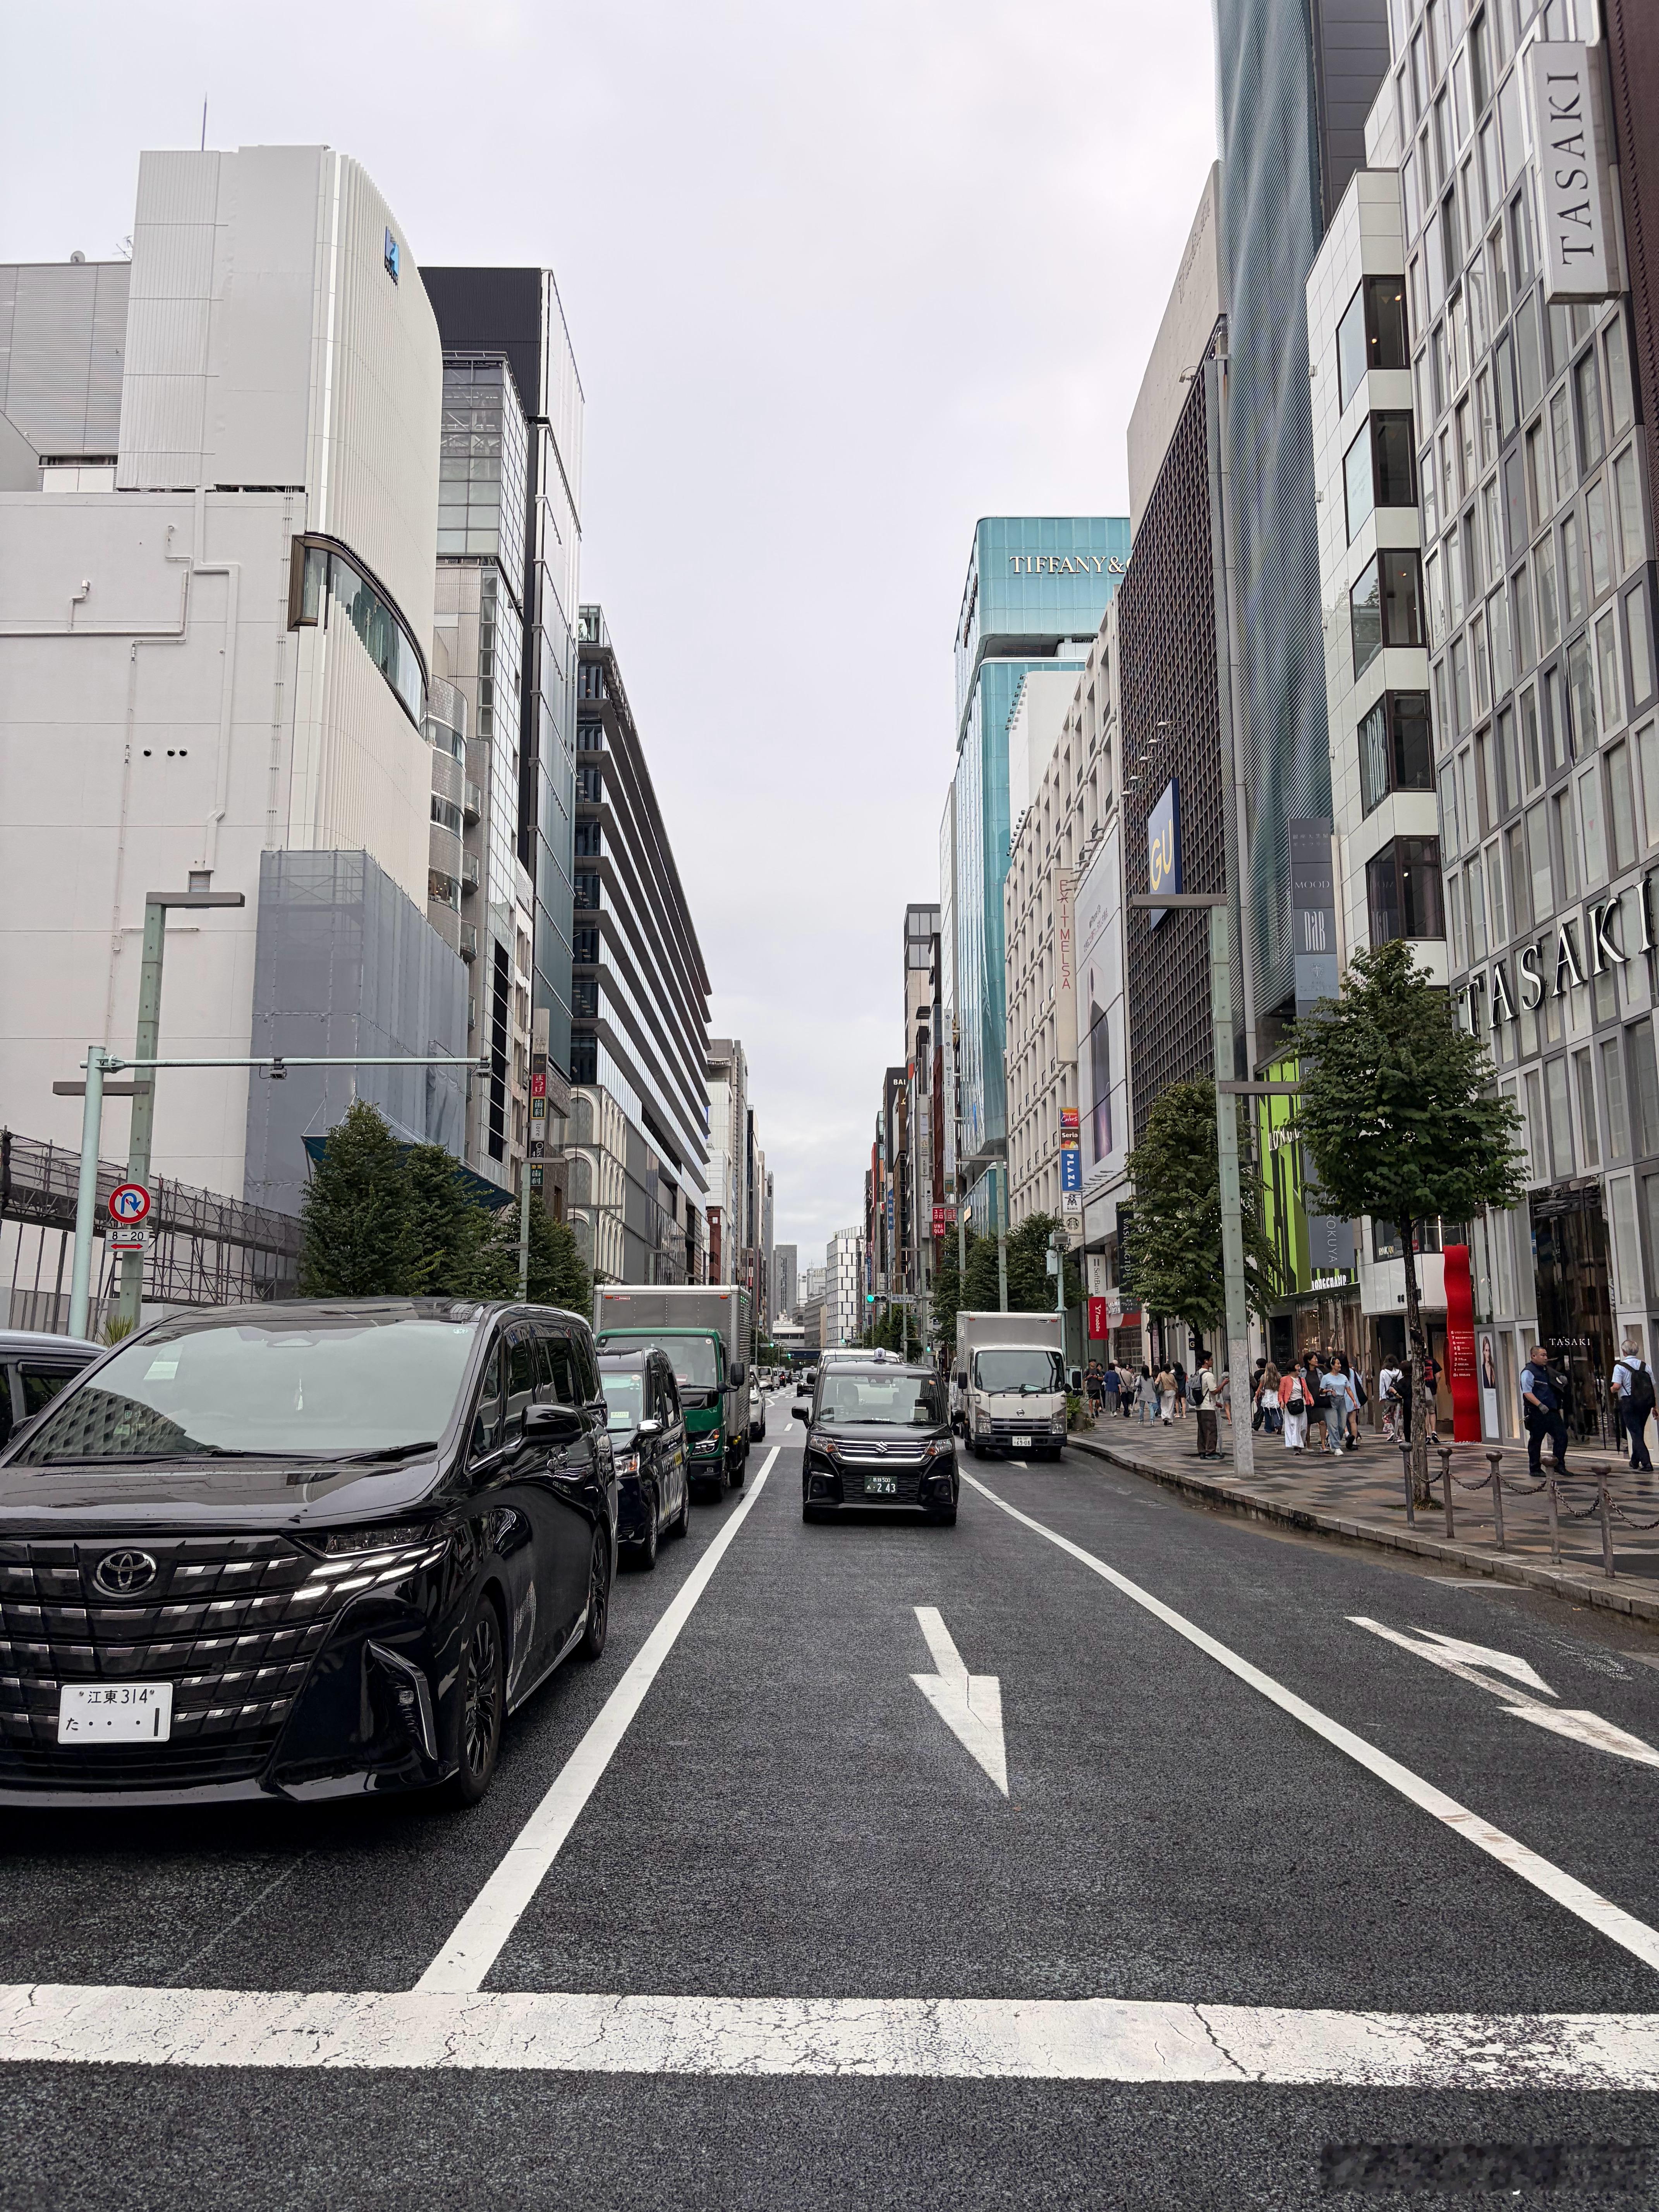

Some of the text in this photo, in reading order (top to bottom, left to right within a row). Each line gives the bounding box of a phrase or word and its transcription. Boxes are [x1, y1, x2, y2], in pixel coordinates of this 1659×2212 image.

[1546, 72, 1594, 265] TASAKI
[1151, 819, 1173, 891] GU
[1458, 878, 1658, 1037] TASAKI
[535, 1074, 544, 1092] まつげ
[535, 1099, 543, 1117] 歯科
[1067, 1154, 1075, 1188] PLAZA
[1312, 1274, 1347, 1290] LONGCHAMP
[66, 1717, 79, 1731] た
